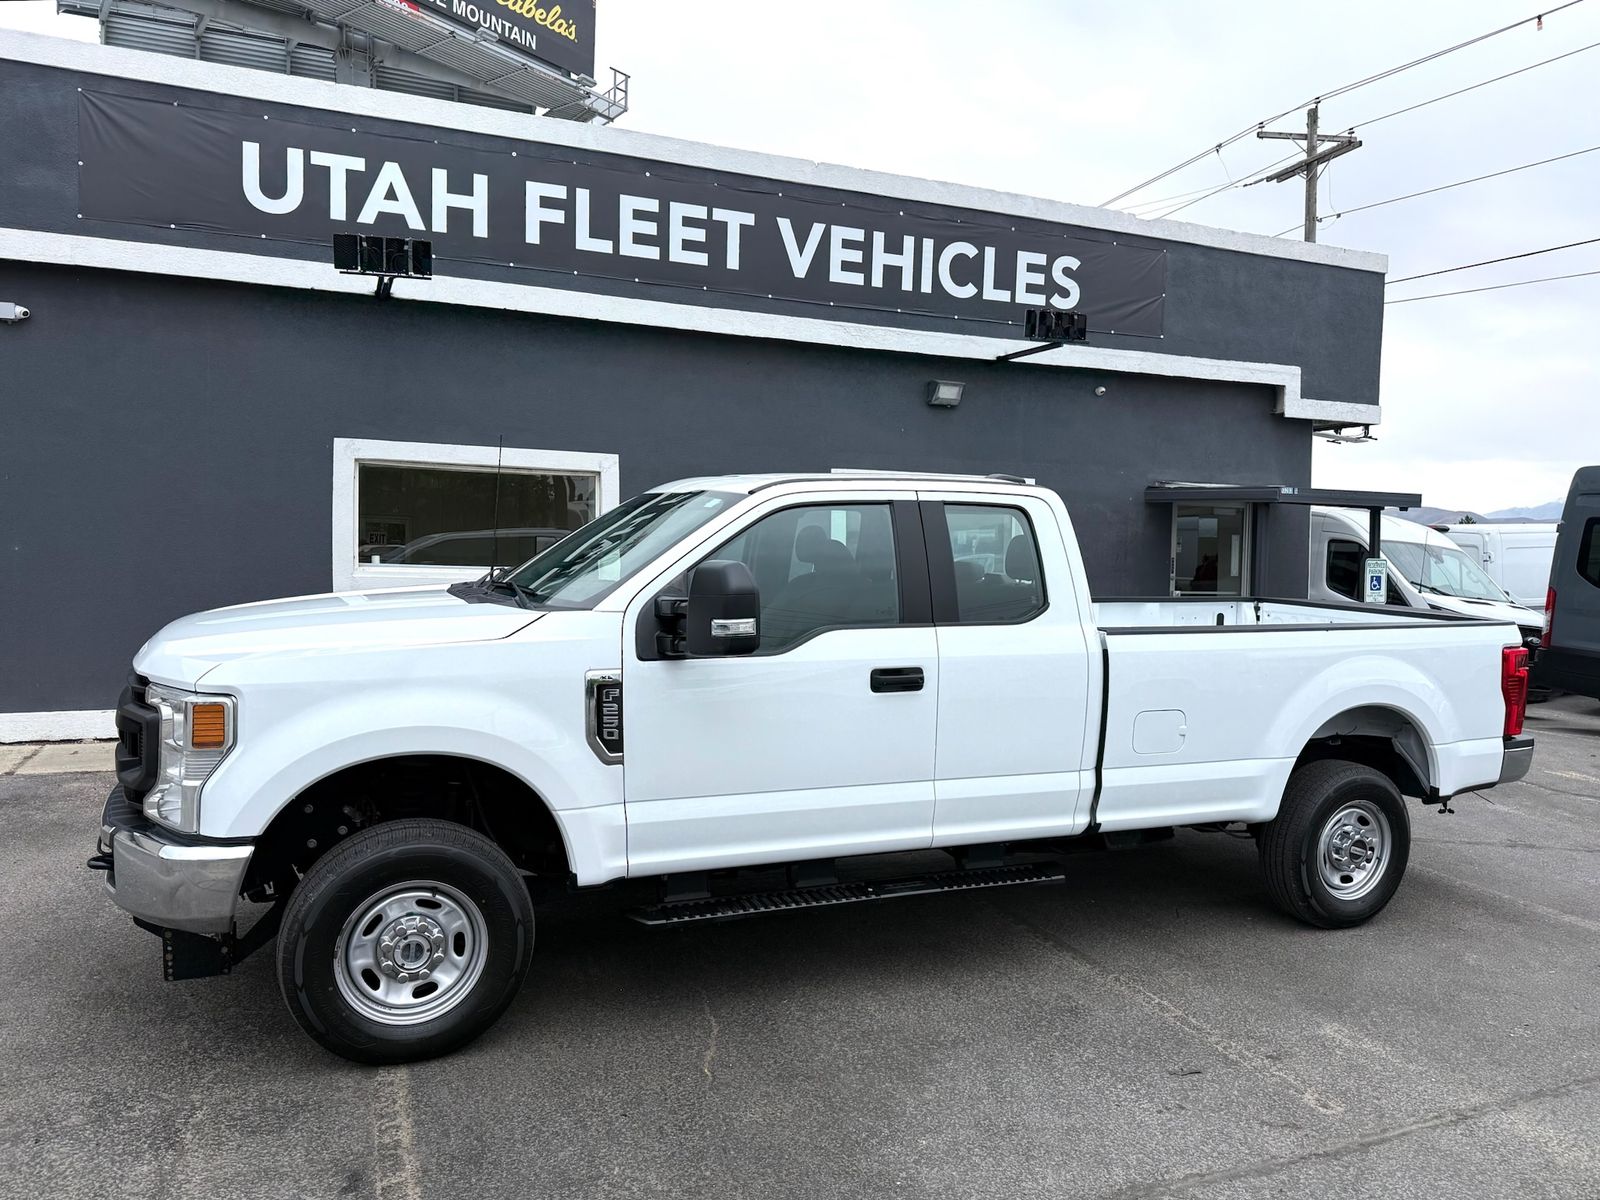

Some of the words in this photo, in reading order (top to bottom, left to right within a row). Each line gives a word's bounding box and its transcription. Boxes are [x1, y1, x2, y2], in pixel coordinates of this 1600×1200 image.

[453, 0, 537, 50] MOUNTAIN
[495, 0, 577, 40] abela's
[242, 140, 489, 239] UTAH
[525, 180, 755, 271] FLEET
[776, 216, 1082, 310] VEHICLES
[369, 533, 386, 544] EXIT
[603, 688, 619, 740] F250
